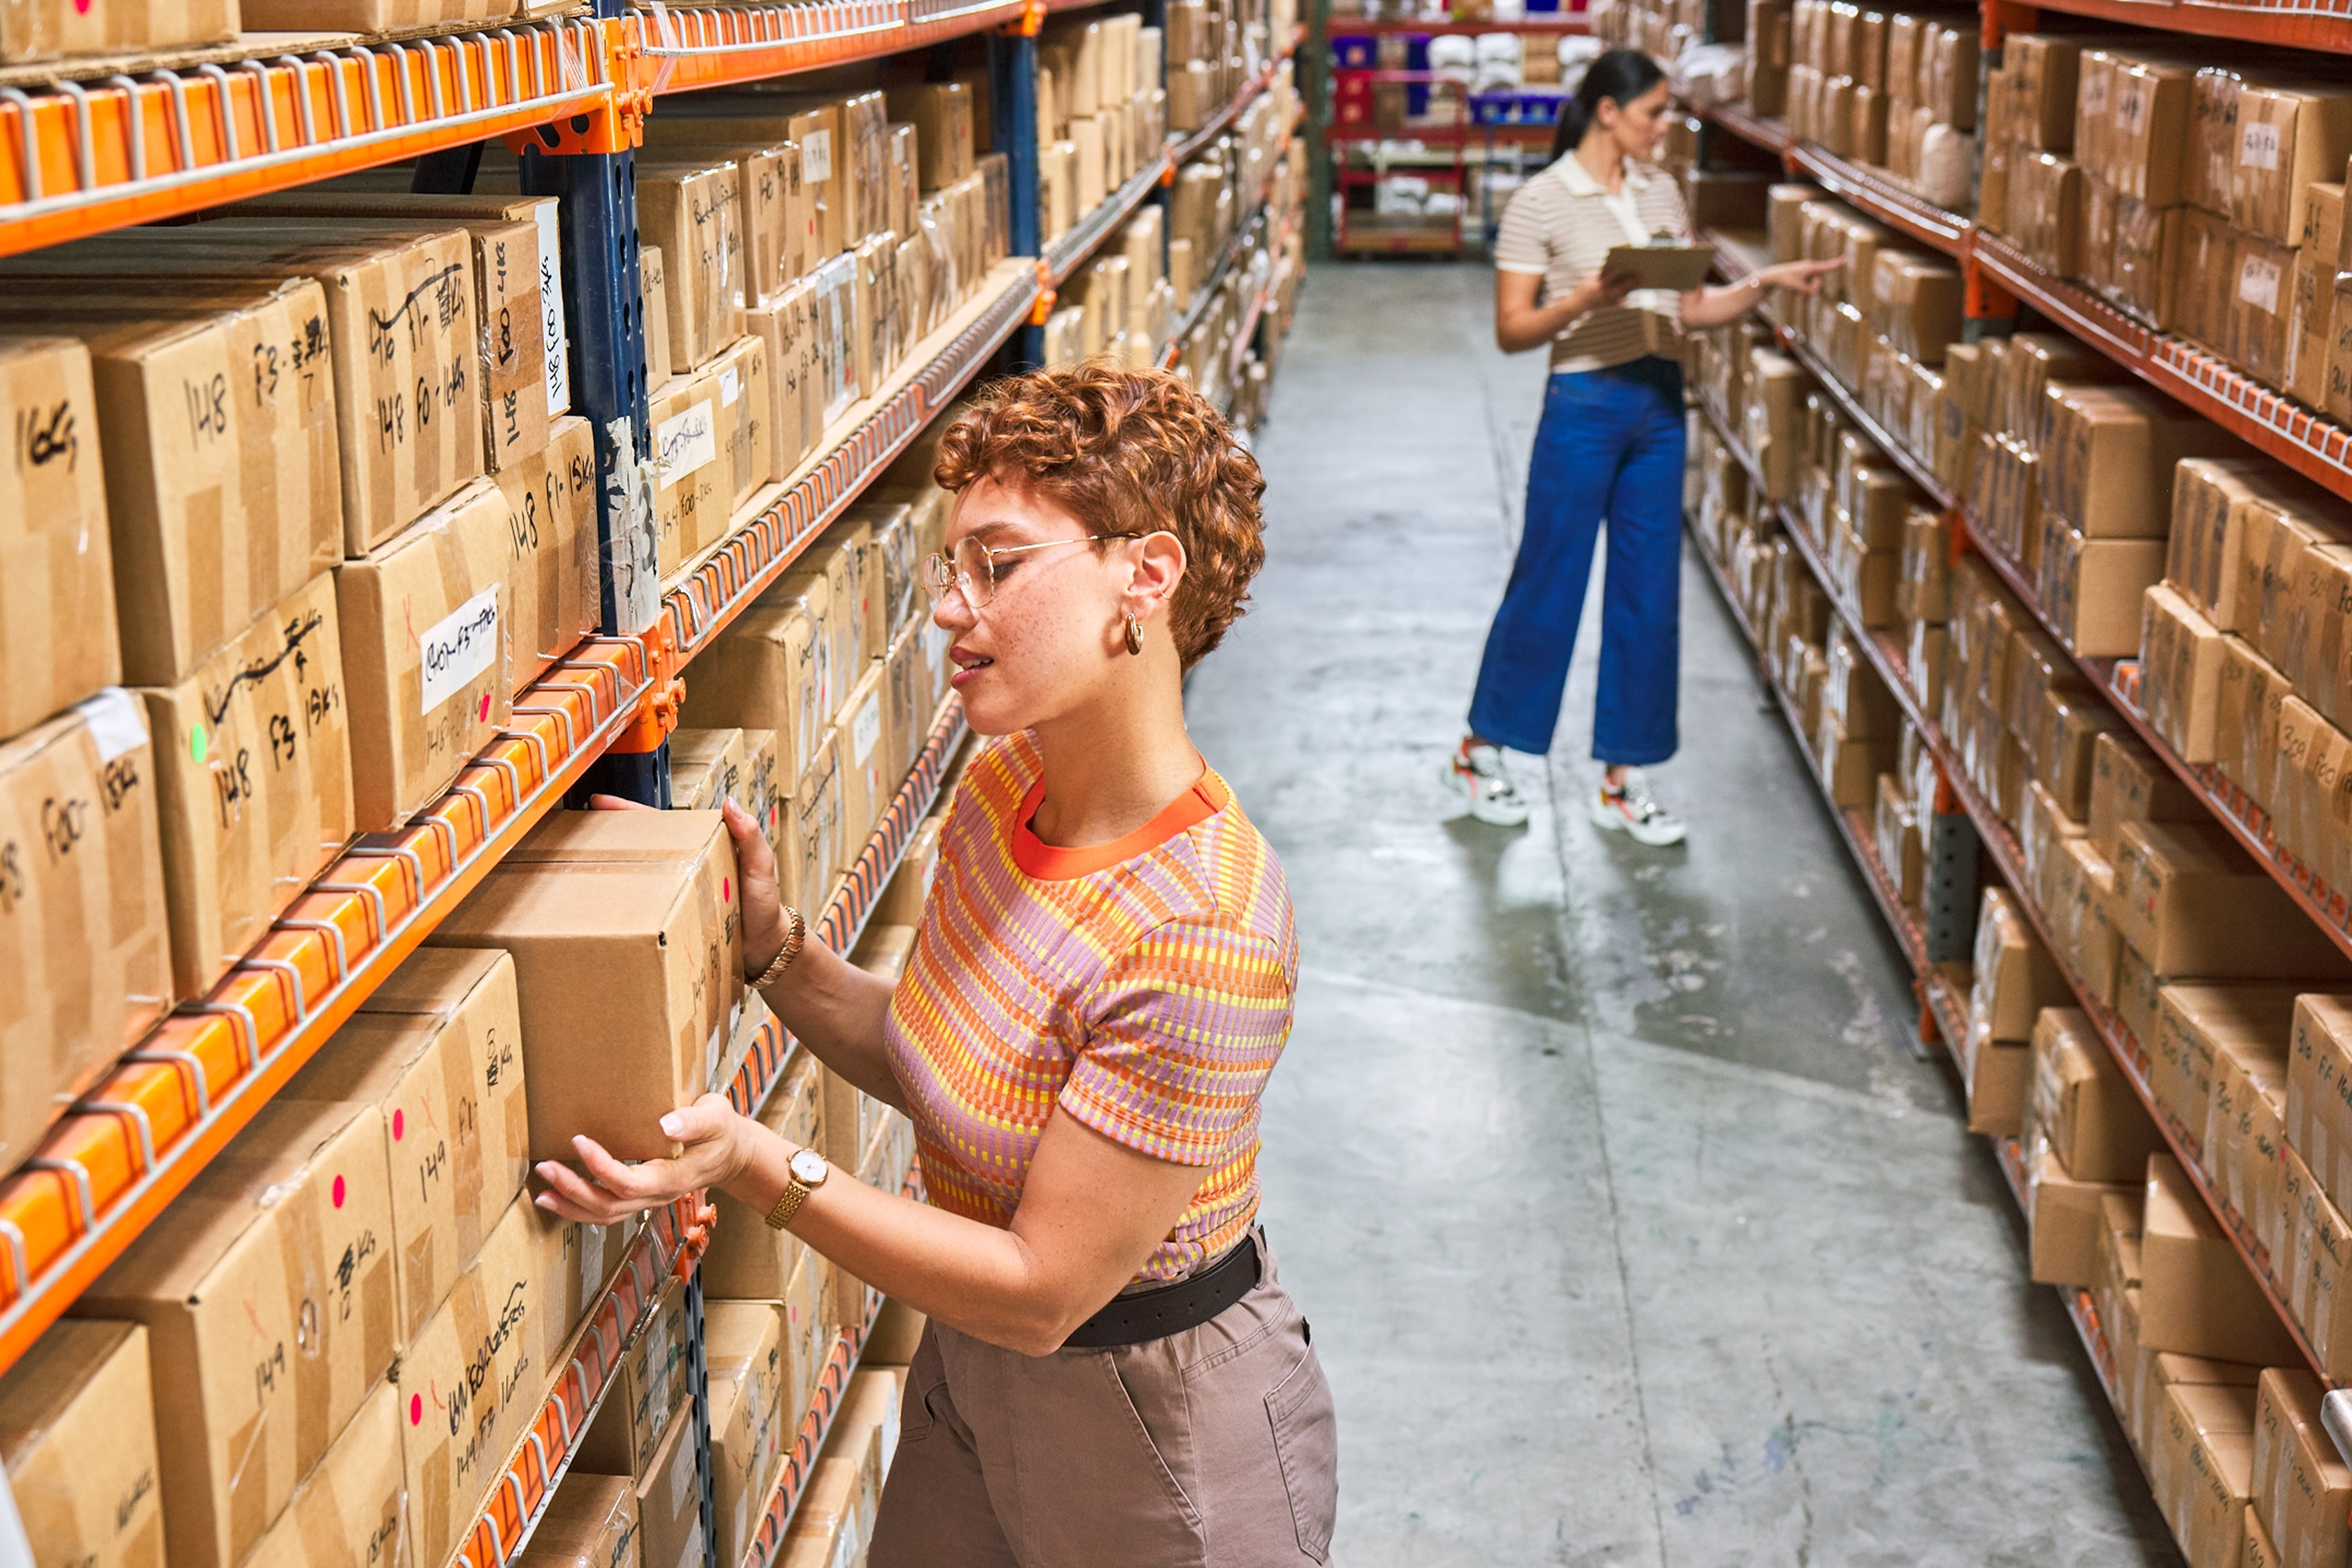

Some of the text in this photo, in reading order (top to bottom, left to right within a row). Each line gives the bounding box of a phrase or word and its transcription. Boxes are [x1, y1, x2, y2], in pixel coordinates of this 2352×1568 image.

[509, 491, 538, 562] 148
[214, 748, 252, 829] 148
[420, 1140, 446, 1203] 149
[255, 1342, 286, 1407] 149
[456, 1436, 476, 1489] 149
